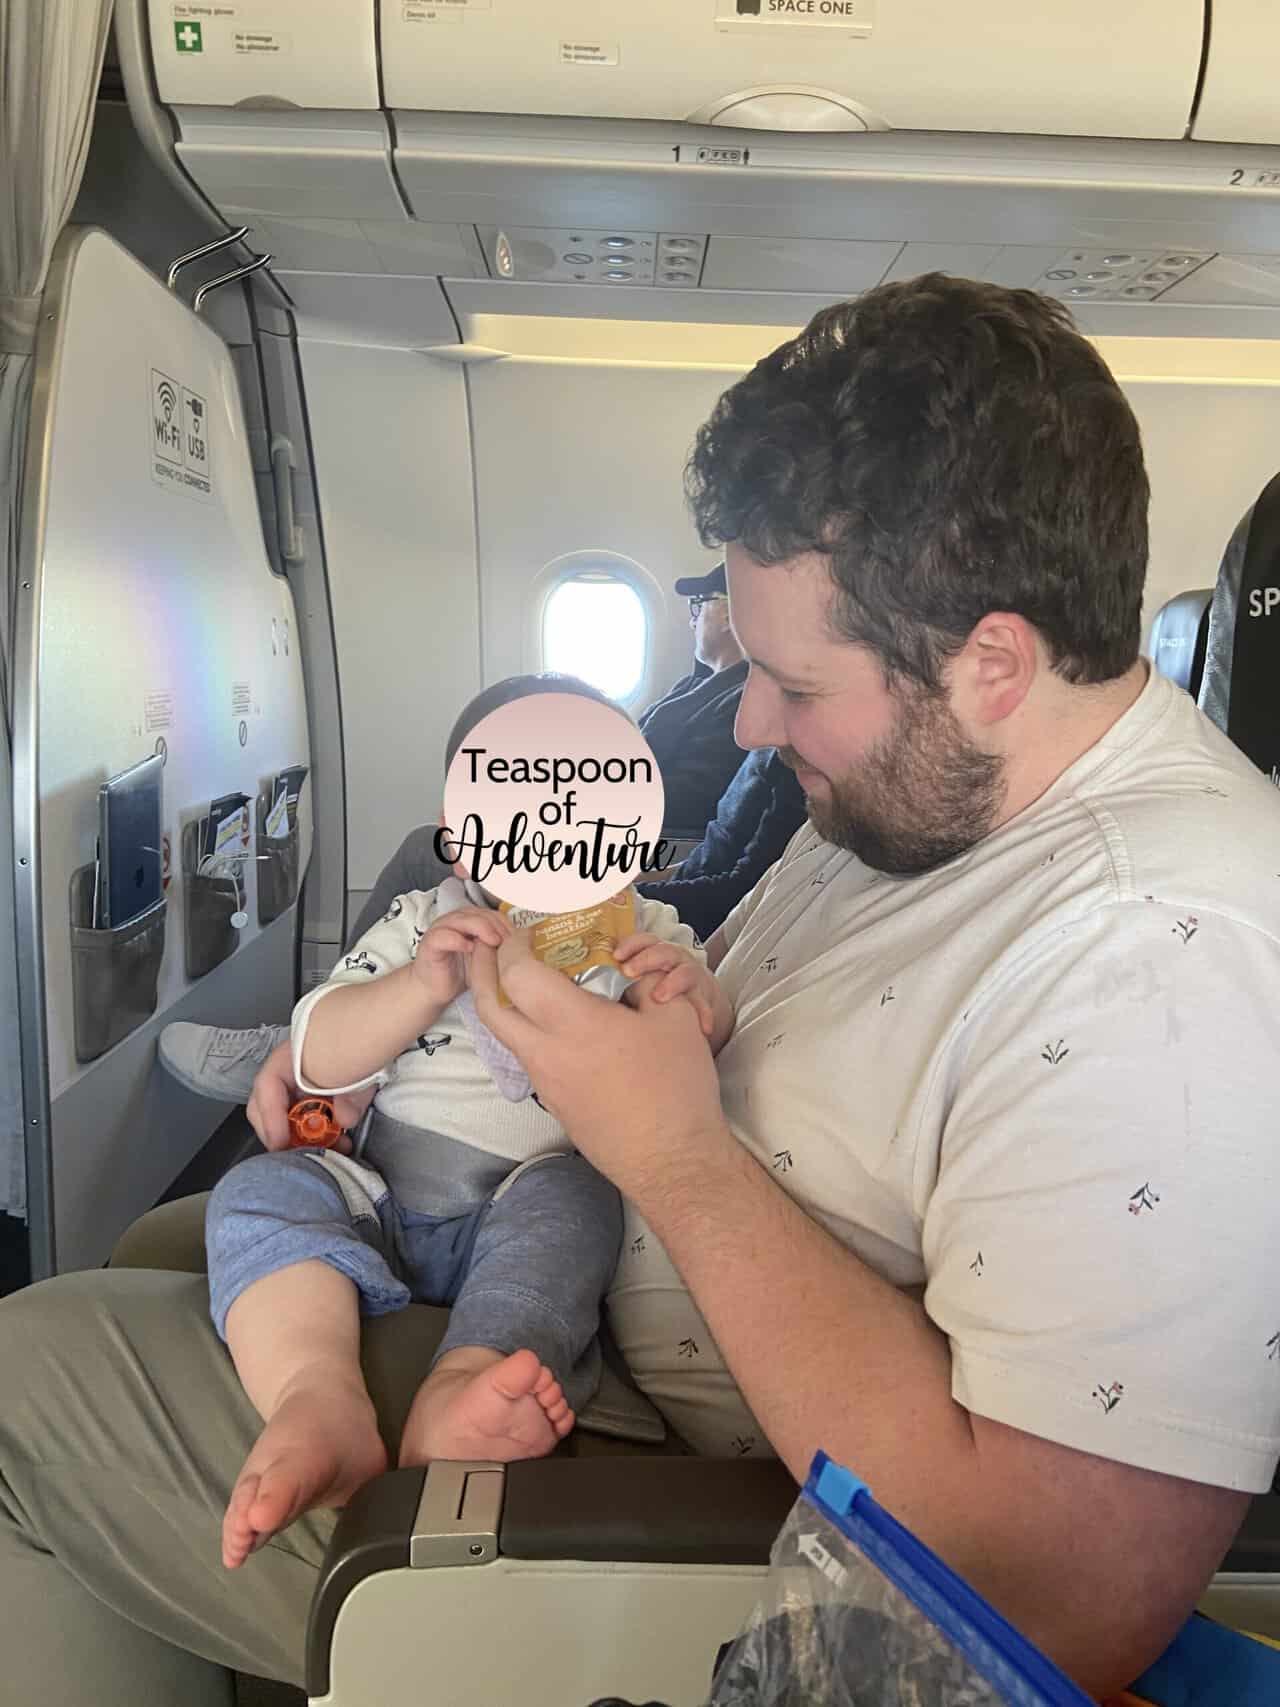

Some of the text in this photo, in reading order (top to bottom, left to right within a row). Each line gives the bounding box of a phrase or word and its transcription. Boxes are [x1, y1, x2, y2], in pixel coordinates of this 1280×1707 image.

[769, 0, 854, 15] SPACE ONE
[672, 145, 681, 163] 1
[1230, 168, 1245, 186] 2
[155, 417, 181, 451] Wi-Fi
[187, 433, 206, 461] USB
